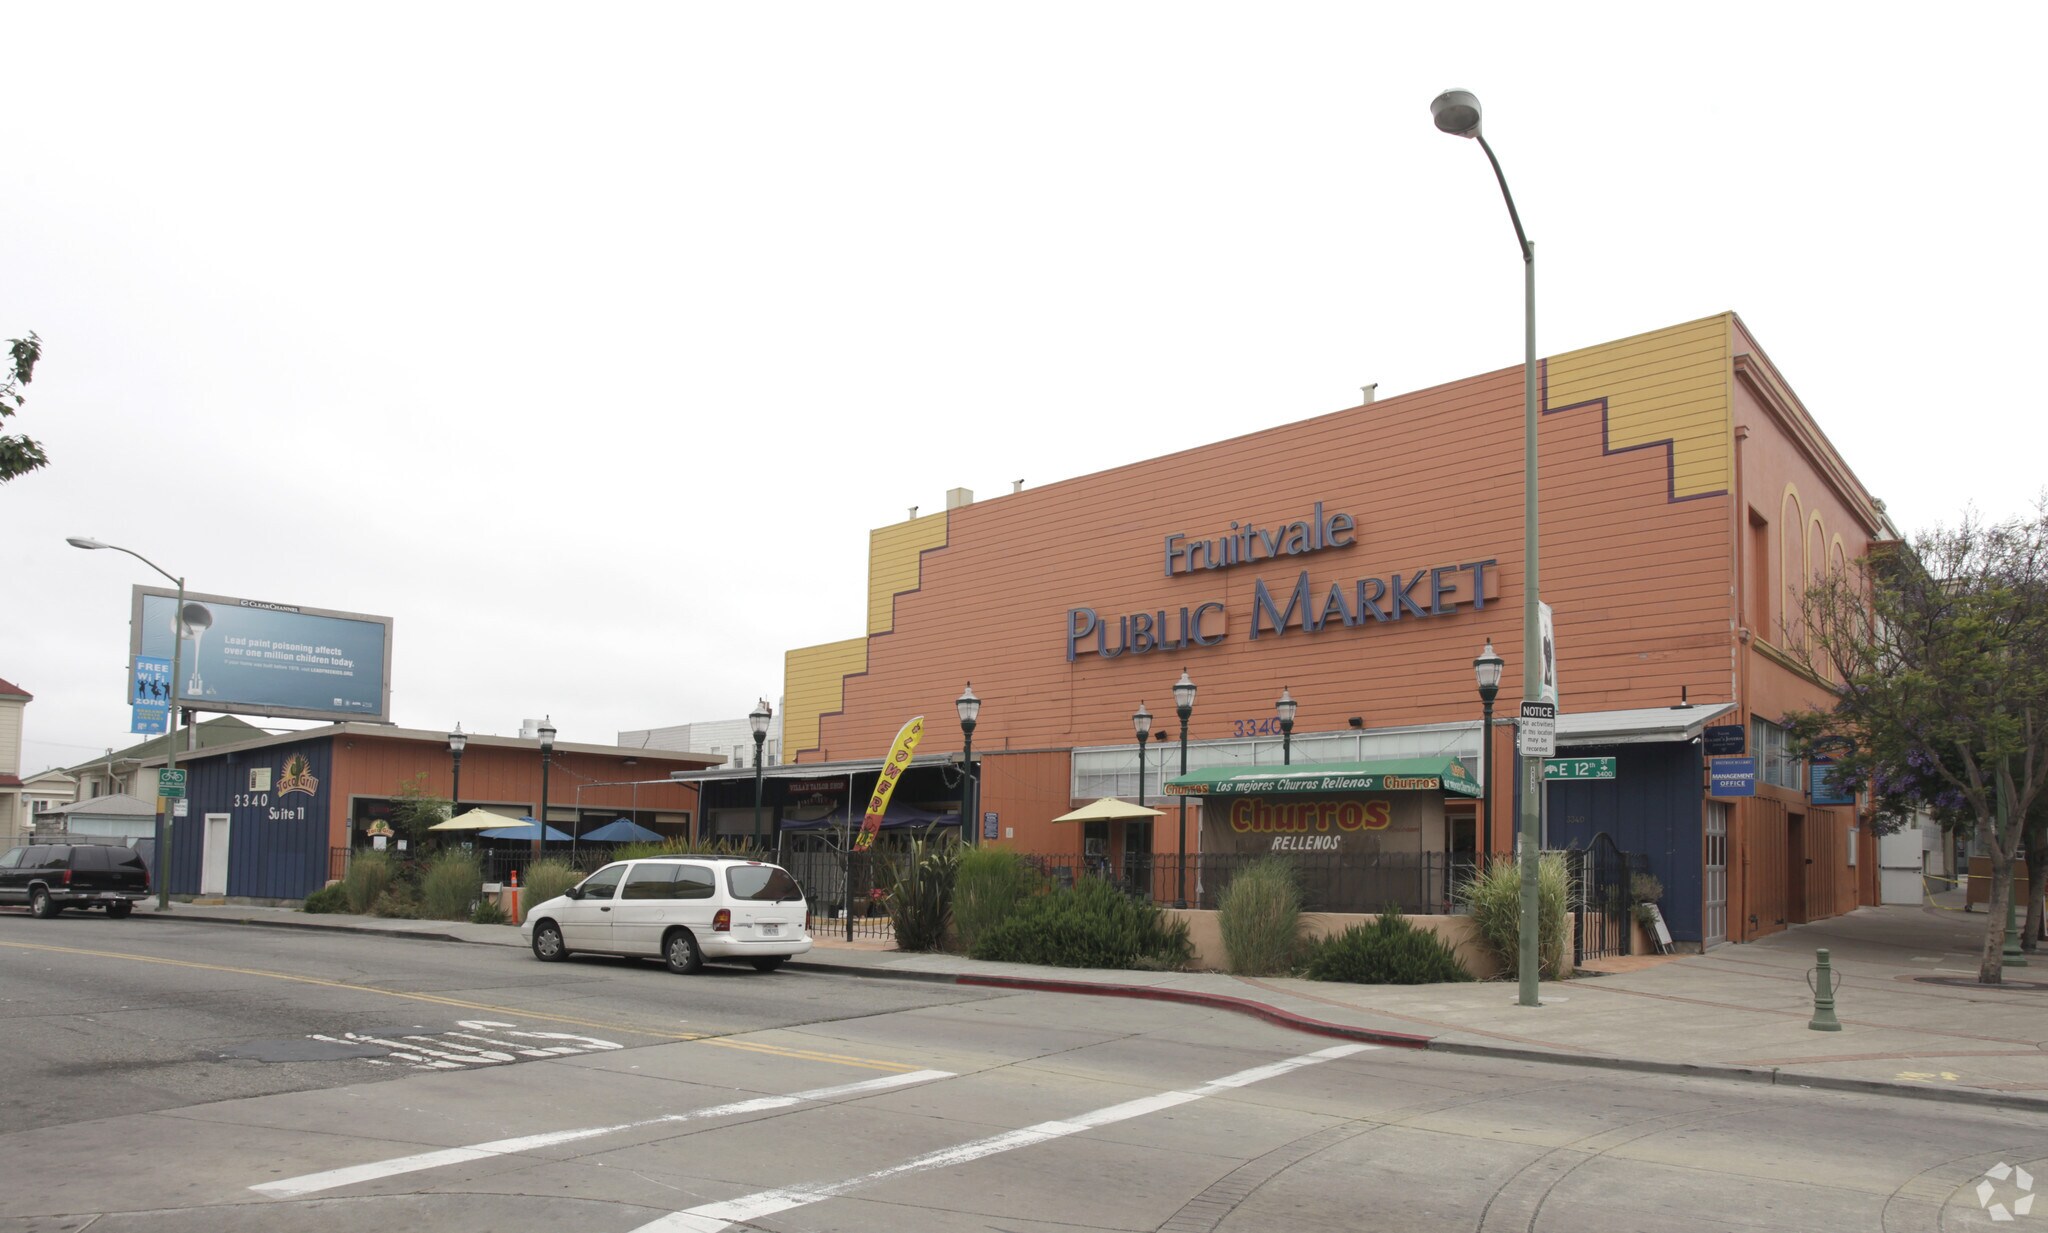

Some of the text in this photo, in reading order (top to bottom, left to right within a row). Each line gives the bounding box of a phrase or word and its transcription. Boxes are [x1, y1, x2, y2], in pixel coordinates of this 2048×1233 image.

[1164, 501, 1356, 577] Fruitvale
[1066, 558, 1497, 662] PUBLIC MARKET
[224, 636, 342, 656] Lead paint poisoning affects
[224, 647, 354, 668] over one million children today.
[138, 662, 168, 672] FREE
[136, 698, 165, 706] zone
[1523, 706, 1553, 718] NOTICE
[1234, 716, 1282, 737] 3340
[1560, 763, 1568, 776] E
[1574, 762, 1596, 776] 12th
[278, 774, 319, 793] Taco Grill
[1164, 783, 1209, 796] Churros
[1216, 777, 1373, 794] Los mejores Churros Rellenos
[1384, 775, 1440, 790] Churros
[234, 794, 268, 807] 3340
[268, 806, 304, 820] Suite 11
[1230, 798, 1392, 833] Churros
[1272, 834, 1341, 851] RELLENOS
